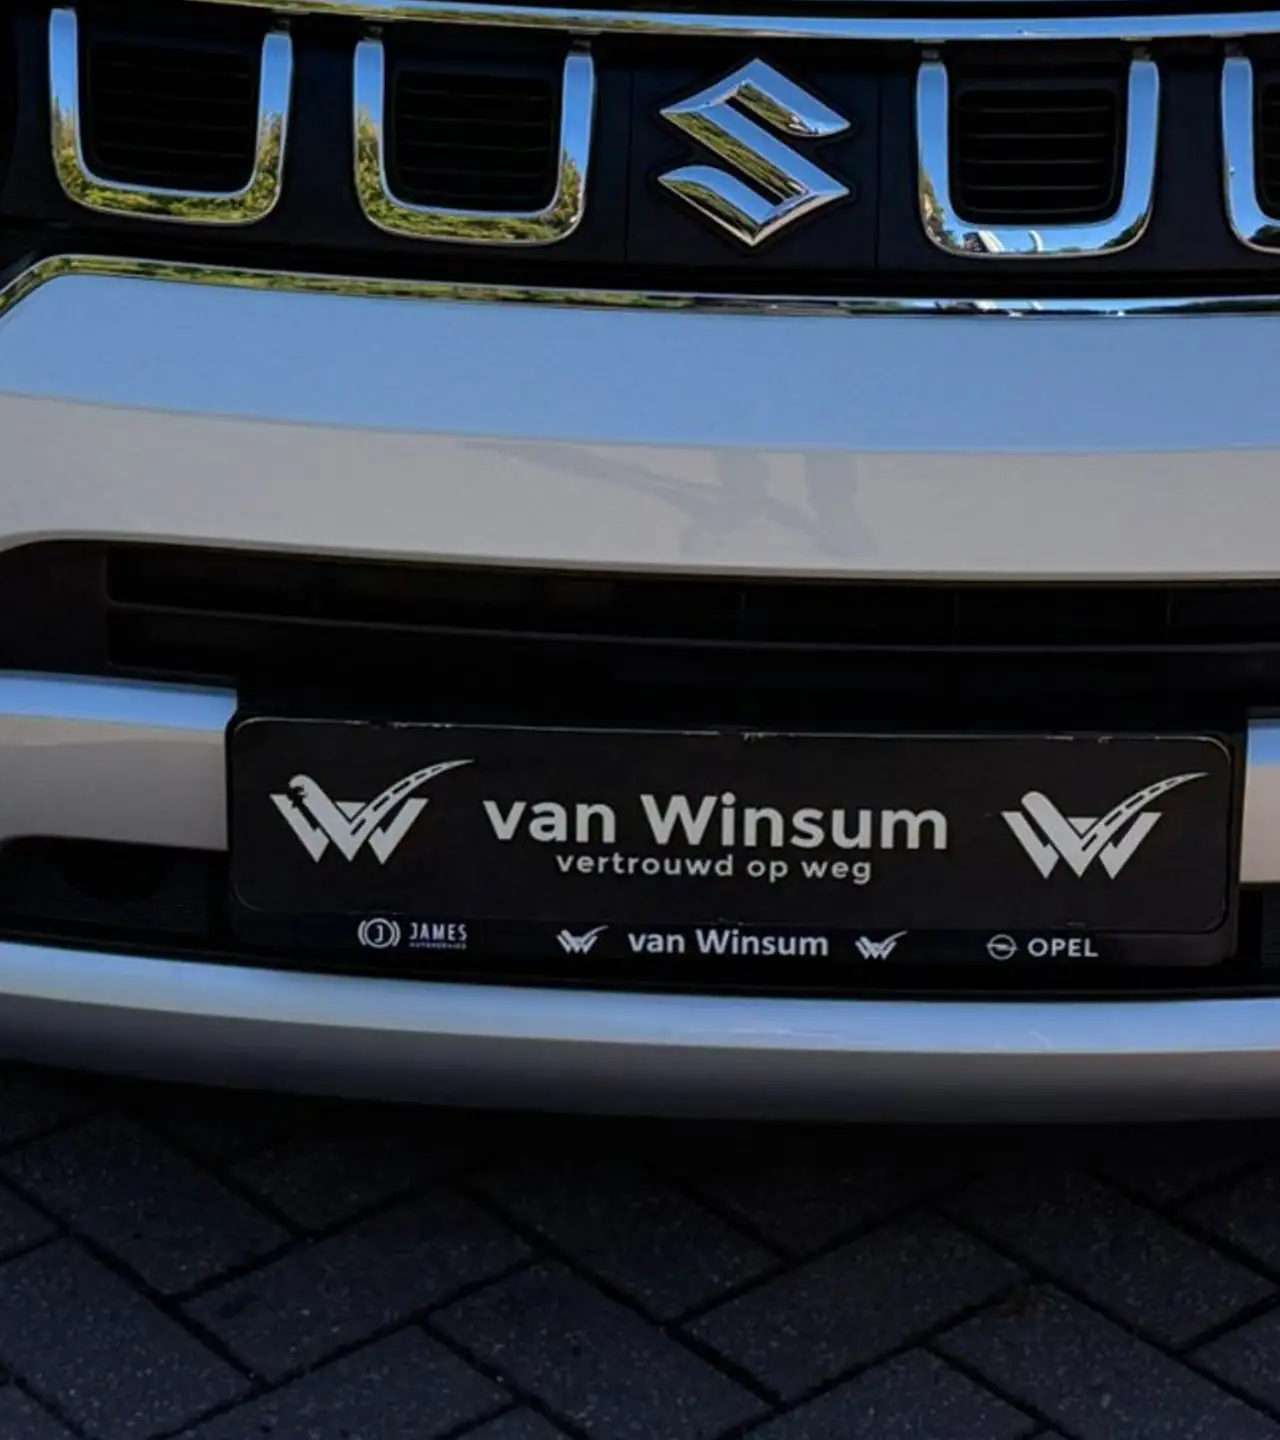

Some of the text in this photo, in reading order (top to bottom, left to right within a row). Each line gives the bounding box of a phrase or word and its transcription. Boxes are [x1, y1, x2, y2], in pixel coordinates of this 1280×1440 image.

[482, 792, 948, 850] van Winsum
[556, 852, 872, 885] vertrouwd op weg
[408, 921, 468, 941] JAMES
[628, 928, 829, 957] van Winsum
[1027, 937, 1099, 958] OPEL
